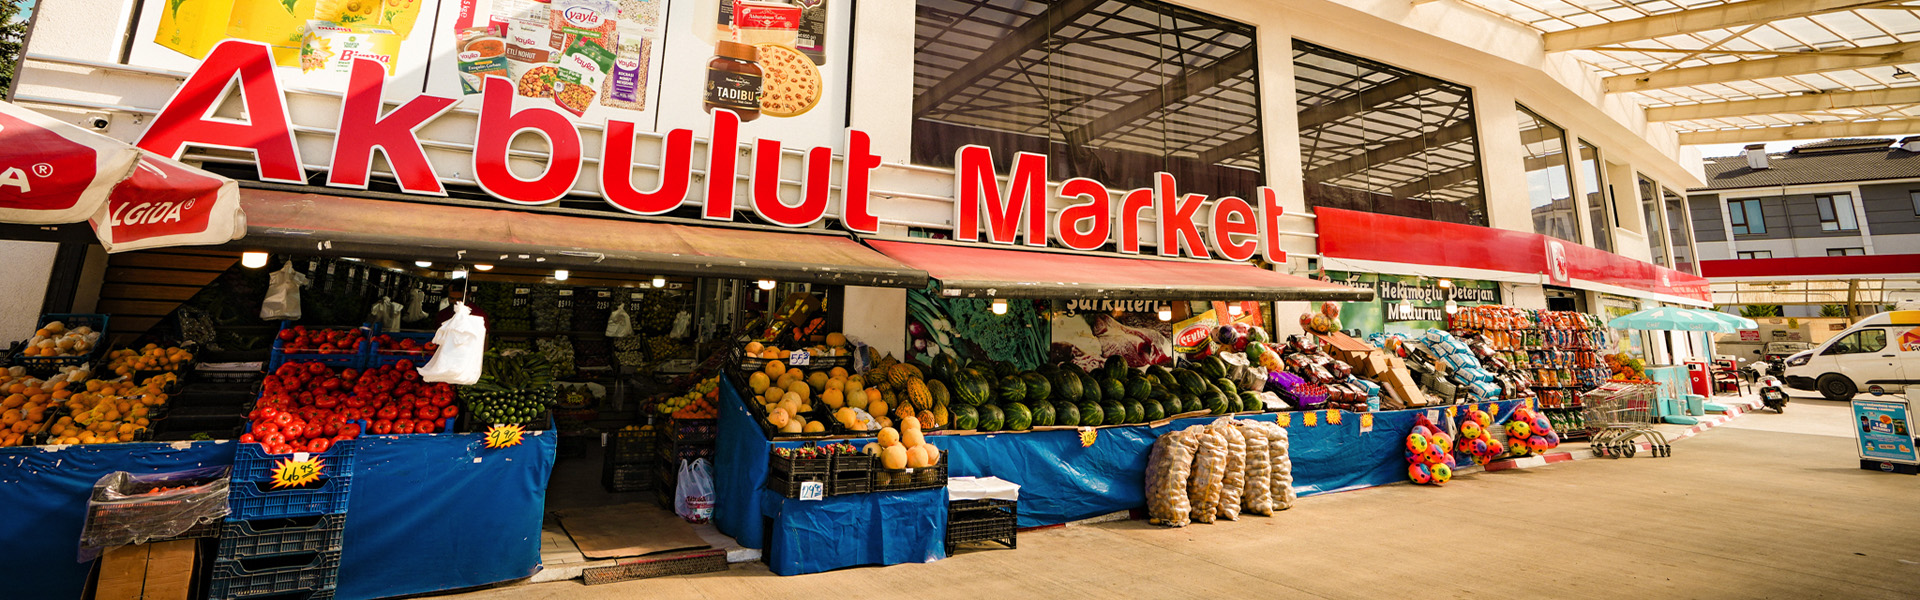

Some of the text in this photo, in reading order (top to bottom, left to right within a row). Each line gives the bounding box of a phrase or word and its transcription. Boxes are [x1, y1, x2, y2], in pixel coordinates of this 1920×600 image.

[567, 11, 598, 24] yayla
[460, 53, 479, 63] Yayla
[518, 49, 536, 59] NOHUT
[618, 60, 637, 68] Yayla
[717, 86, 754, 101] TADIBU
[136, 39, 881, 234] Akbulut
[954, 145, 1288, 265] Market
[1381, 281, 1443, 304] Hekimoğlu
[1448, 283, 1494, 304] Deterjan
[282, 466, 300, 483] 46
